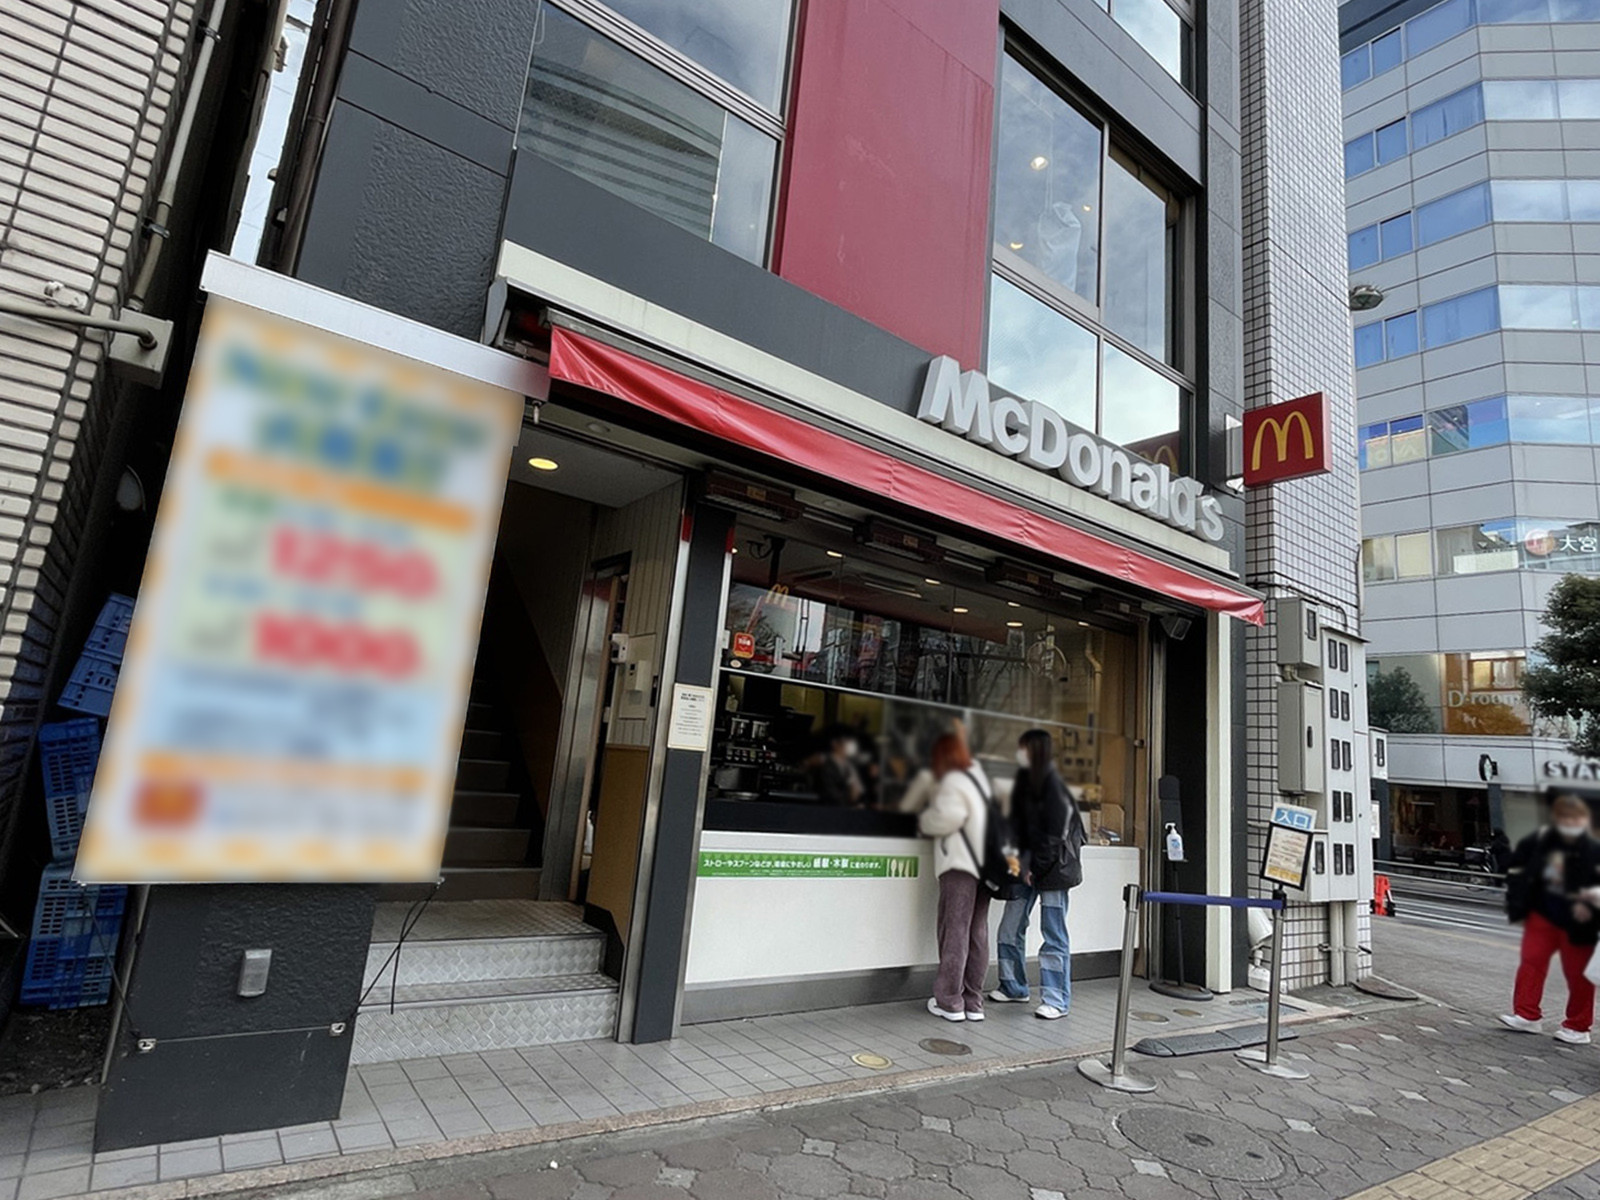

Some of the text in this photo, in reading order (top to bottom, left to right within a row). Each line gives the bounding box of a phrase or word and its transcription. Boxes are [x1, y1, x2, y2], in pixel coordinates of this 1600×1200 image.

[917, 355, 1224, 542] McDonald's
[1559, 533, 1598, 553] 大宮
[1276, 809, 1310, 829] 入口
